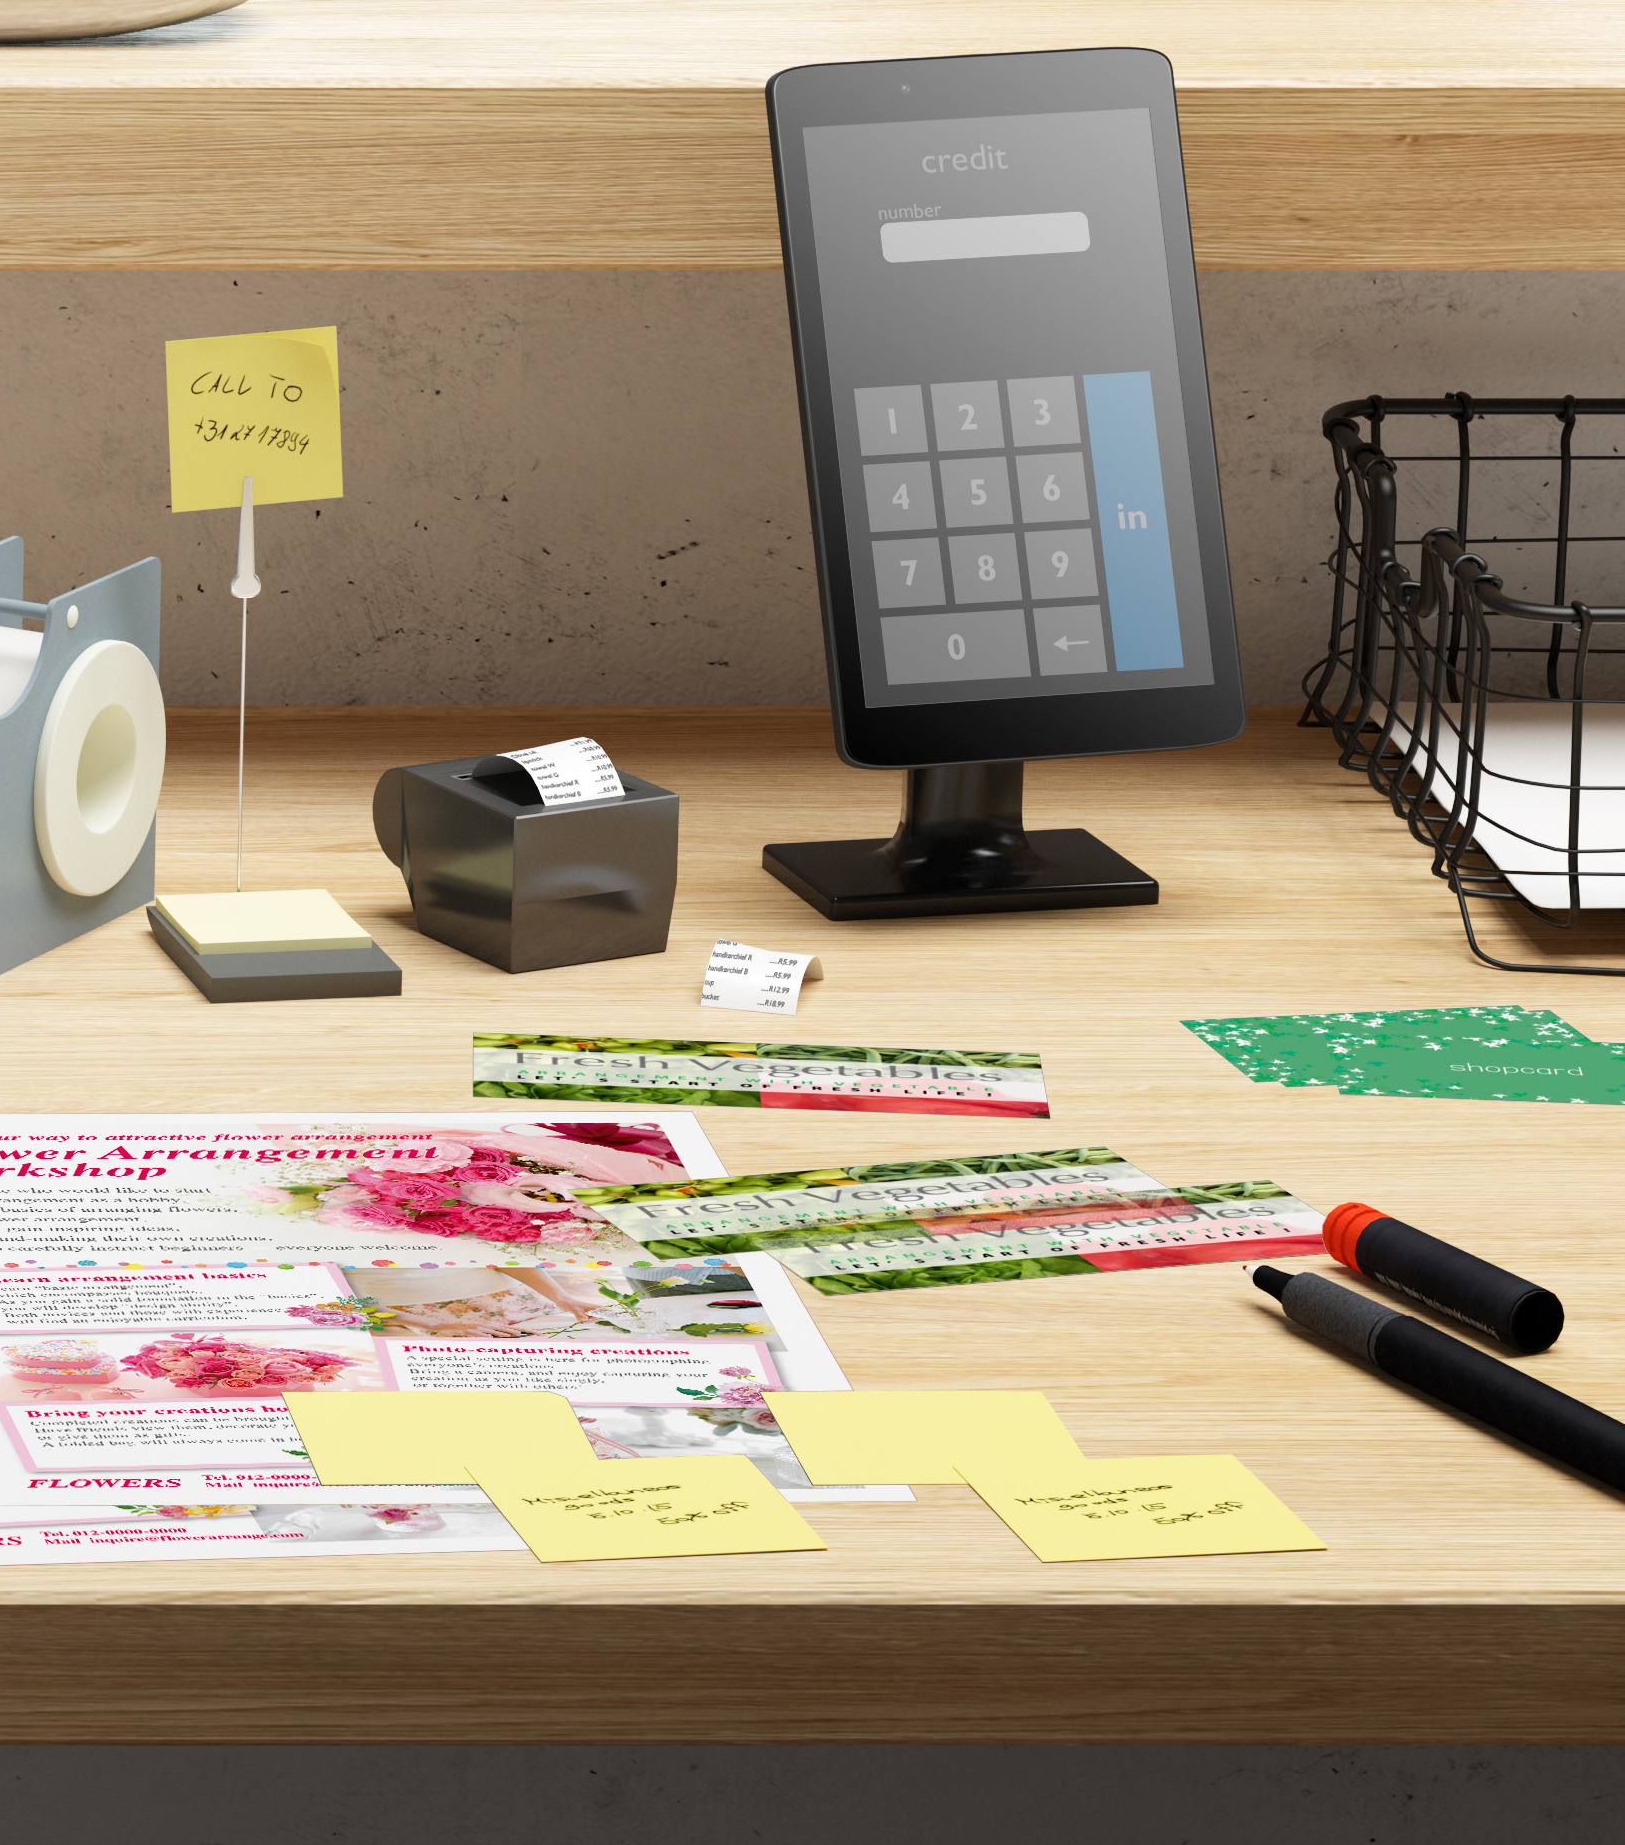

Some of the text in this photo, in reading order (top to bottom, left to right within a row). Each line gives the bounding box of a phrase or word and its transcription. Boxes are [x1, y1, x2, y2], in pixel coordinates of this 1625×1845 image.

[921, 143, 1009, 174] credit
[878, 203, 942, 221] number
[190, 371, 303, 403] CALL TO
[959, 404, 978, 431] 2
[1034, 399, 1051, 426] 3
[891, 475, 1061, 511] 4 5 6
[1116, 502, 1148, 530] in
[900, 550, 1069, 587] 7 8 9
[947, 633, 967, 662] 0
[515, 1052, 1003, 1083] Fresh Vegetables
[518, 1069, 995, 1093] ARRANGEMENT WITH VEGETABLE
[1449, 1062, 1585, 1077] shopcard
[27, 1134, 71, 1143] way
[104, 1133, 207, 1142] attractive
[211, 1133, 285, 1143] flower
[289, 1133, 434, 1143] arrangement
[97, 1145, 440, 1164] Arrangement
[636, 1171, 1110, 1219] Fresh Vegetables
[965, 1206, 1277, 1239] Vegetables
[57, 1273, 194, 1284] arrangement
[27, 1478, 182, 1489] FLOWERS
[45, 1537, 82, 1545] Mail
